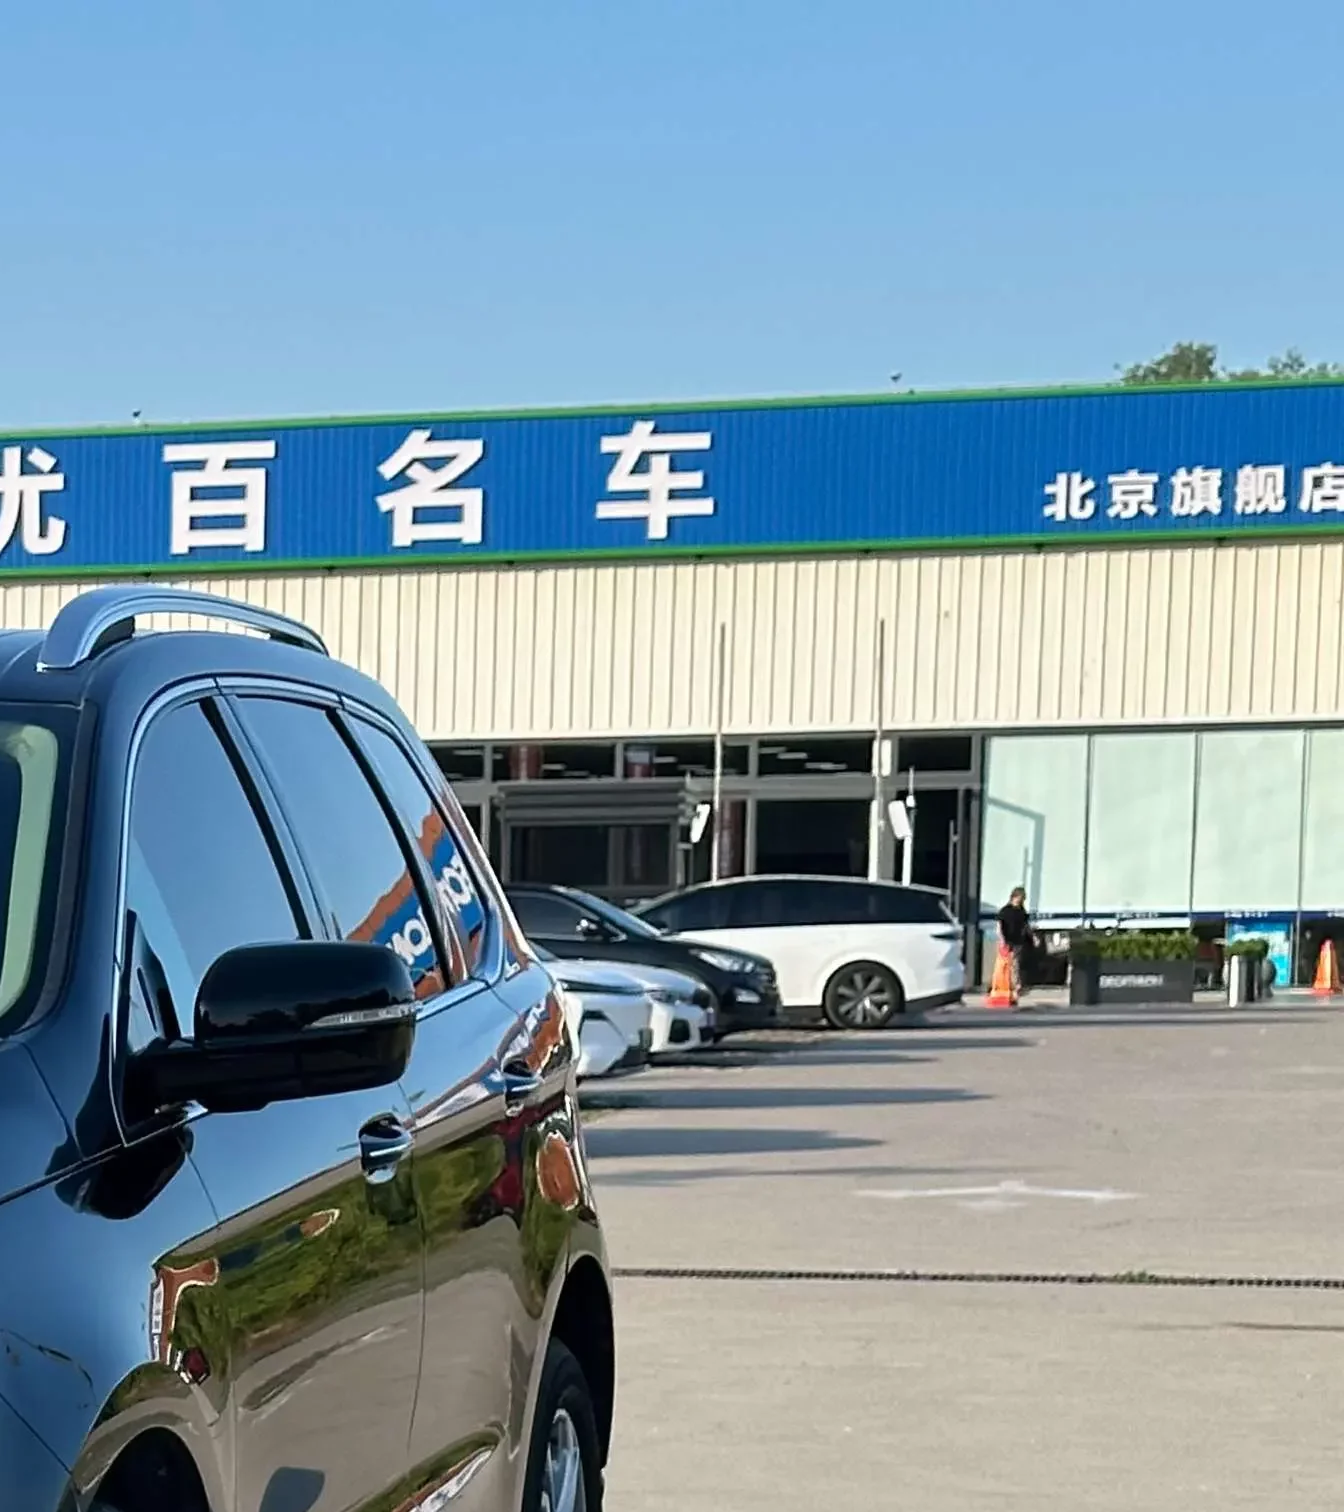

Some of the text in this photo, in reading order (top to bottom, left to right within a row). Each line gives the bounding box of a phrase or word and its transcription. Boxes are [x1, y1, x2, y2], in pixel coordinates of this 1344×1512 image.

[1043, 462, 1344, 522] 北京旗舰店
